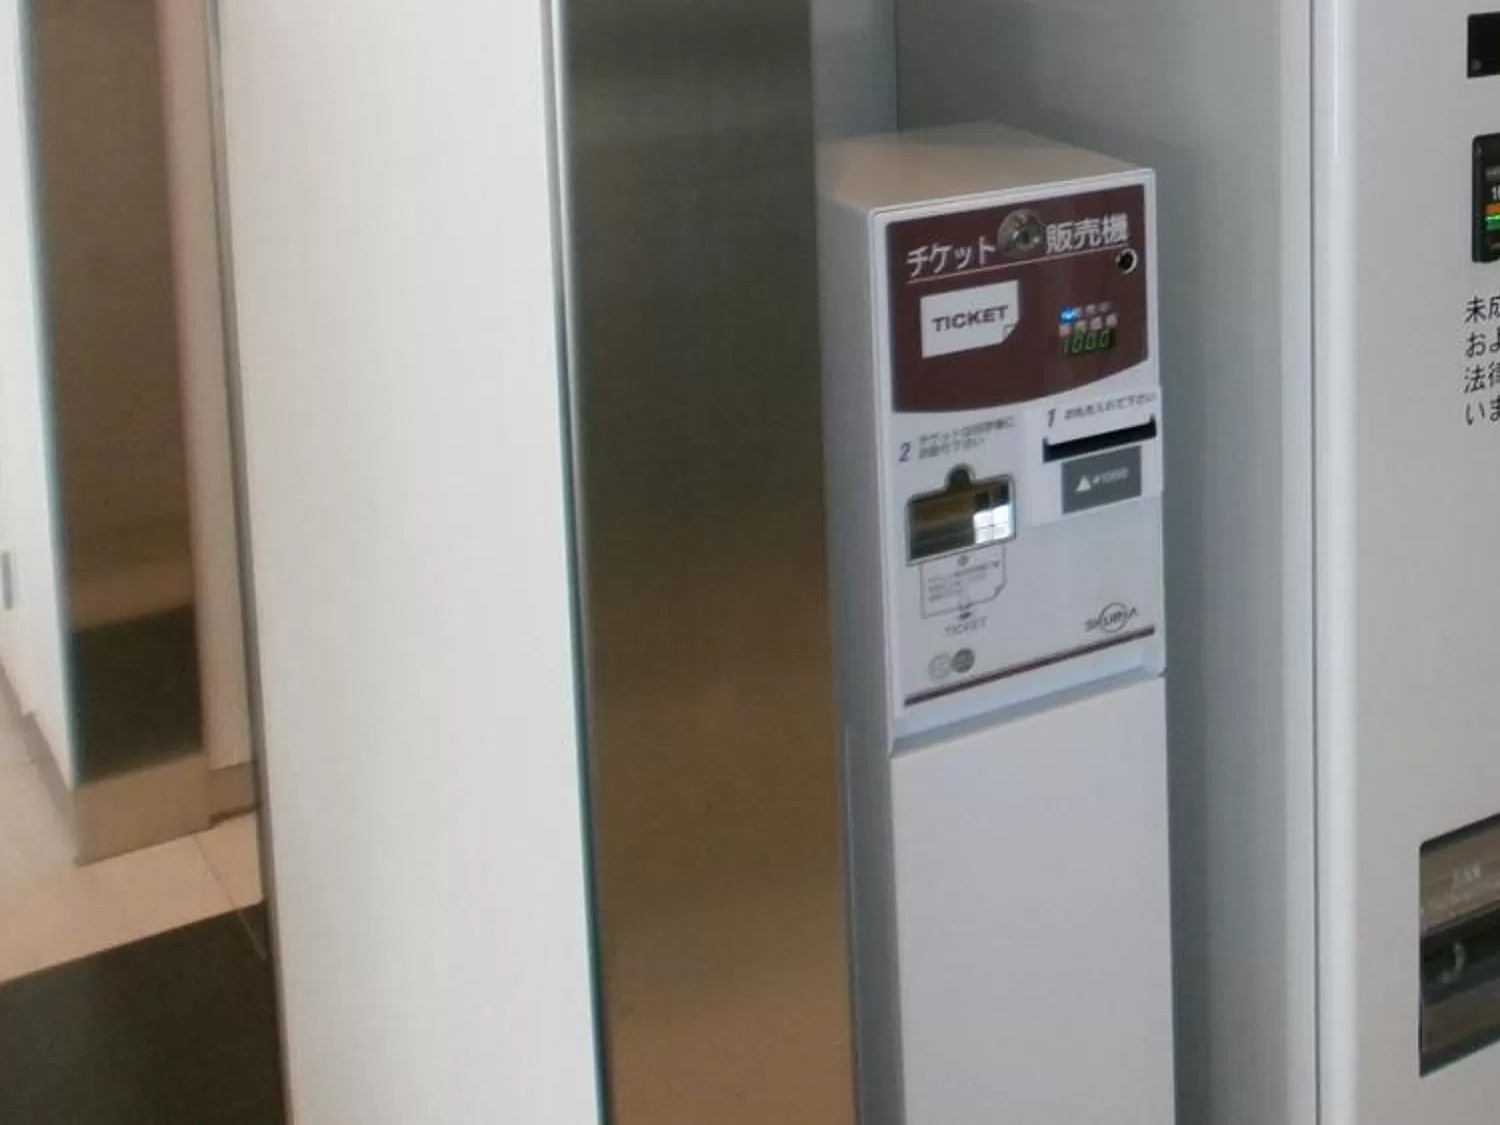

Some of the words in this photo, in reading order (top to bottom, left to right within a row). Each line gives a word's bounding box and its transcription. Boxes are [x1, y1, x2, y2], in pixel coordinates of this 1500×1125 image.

[906, 235, 995, 277] チケット
[1046, 212, 1128, 254] 販売機
[932, 305, 1009, 332] TICKET
[898, 442, 912, 462] 2
